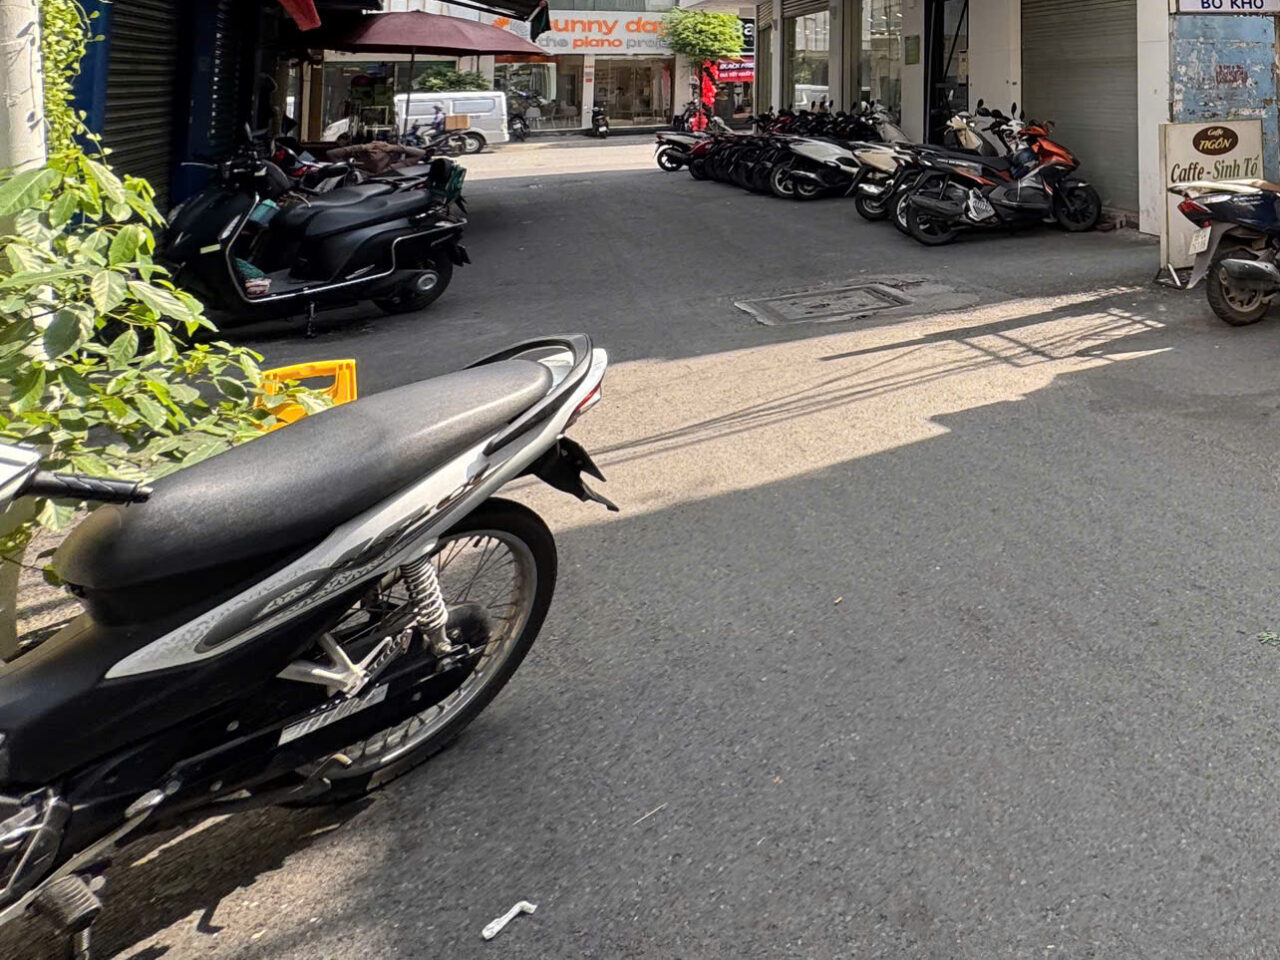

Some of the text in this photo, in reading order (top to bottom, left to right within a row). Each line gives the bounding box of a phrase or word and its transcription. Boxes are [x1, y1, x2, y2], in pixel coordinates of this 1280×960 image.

[550, 17, 619, 36] unny
[573, 37, 623, 50] piano
[1170, 161, 1205, 183] Caffe
[1212, 159, 1241, 180] Sinh
